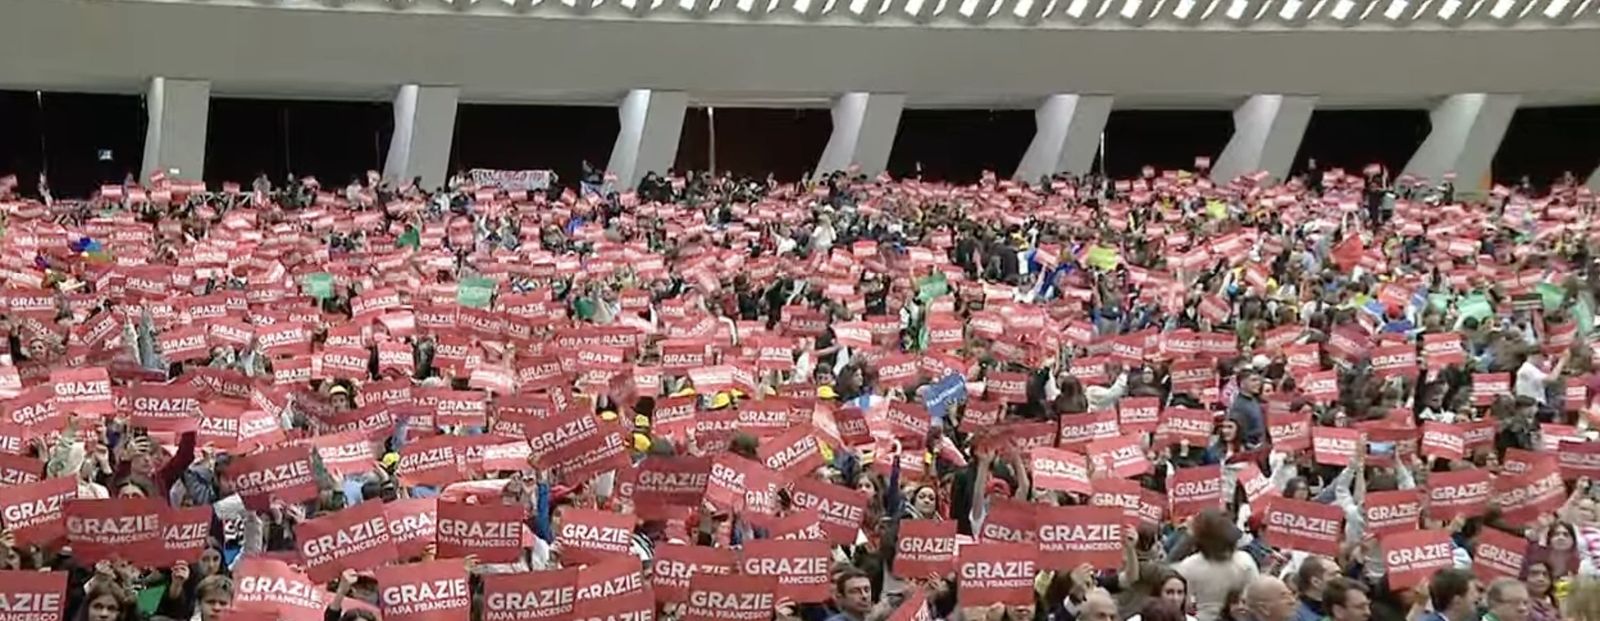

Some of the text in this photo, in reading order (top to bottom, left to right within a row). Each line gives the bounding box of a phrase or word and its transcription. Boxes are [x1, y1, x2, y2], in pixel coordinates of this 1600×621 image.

[11, 297, 54, 306] GRAZIE
[191, 305, 226, 315] GRAZIE
[162, 334, 205, 349] GRAZIE
[258, 329, 303, 344] GRAZIE
[325, 354, 369, 367] GRAZIE
[663, 354, 703, 363] GRAZIE
[275, 368, 311, 379] GRAZIE
[521, 364, 561, 378] GRAZIE
[879, 363, 916, 376] GRAZIE
[55, 381, 110, 395] GRAZIE
[134, 398, 197, 412] GRAZIE
[438, 401, 483, 410] GRAZIE
[739, 411, 787, 423] GRAZIE
[531, 415, 596, 450] GRAZIE
[319, 441, 370, 457] GRAZIE
[401, 447, 453, 467] GRAZIE
[767, 434, 816, 469] GRAZIE
[236, 460, 311, 490] GRAZIE
[638, 471, 708, 485] GRAZIE
[1431, 481, 1490, 500] GRAZIE
[4, 491, 76, 521] GRAZ
[1367, 502, 1419, 521] GRAZIE
[66, 514, 159, 534] GRAZIE
[162, 521, 209, 541] AZIE
[439, 519, 521, 538] GRAZIE
[1270, 511, 1341, 534] GRAZIE
[303, 516, 386, 557] GRAZIE
[562, 524, 631, 544] GRAZIE
[1039, 525, 1121, 541] GRAZIE
[307, 533, 390, 569] PAPA FRANCESCO
[462, 537, 520, 548] FRANCESCO
[581, 541, 628, 553] FRANCESCO
[900, 537, 953, 553] GRAZIE
[1040, 542, 1122, 550] PAPA FRANCESCO
[1387, 543, 1450, 565] GRAZIE
[1478, 543, 1523, 565] GRAZIE
[745, 558, 828, 575] GRAZIE
[961, 561, 1035, 579] GRAZIE
[240, 576, 322, 602] GRAZIE
[383, 578, 467, 606] GRAZIE
[0, 592, 61, 612] AZIE
[385, 597, 468, 616] PAPA FRANCESCO
[487, 586, 576, 611] GRAZIE
[691, 591, 774, 610] GRAZIE
[487, 604, 573, 621] PAPA FRANCESCO
[689, 606, 771, 621] PAPA FRANCESCO
